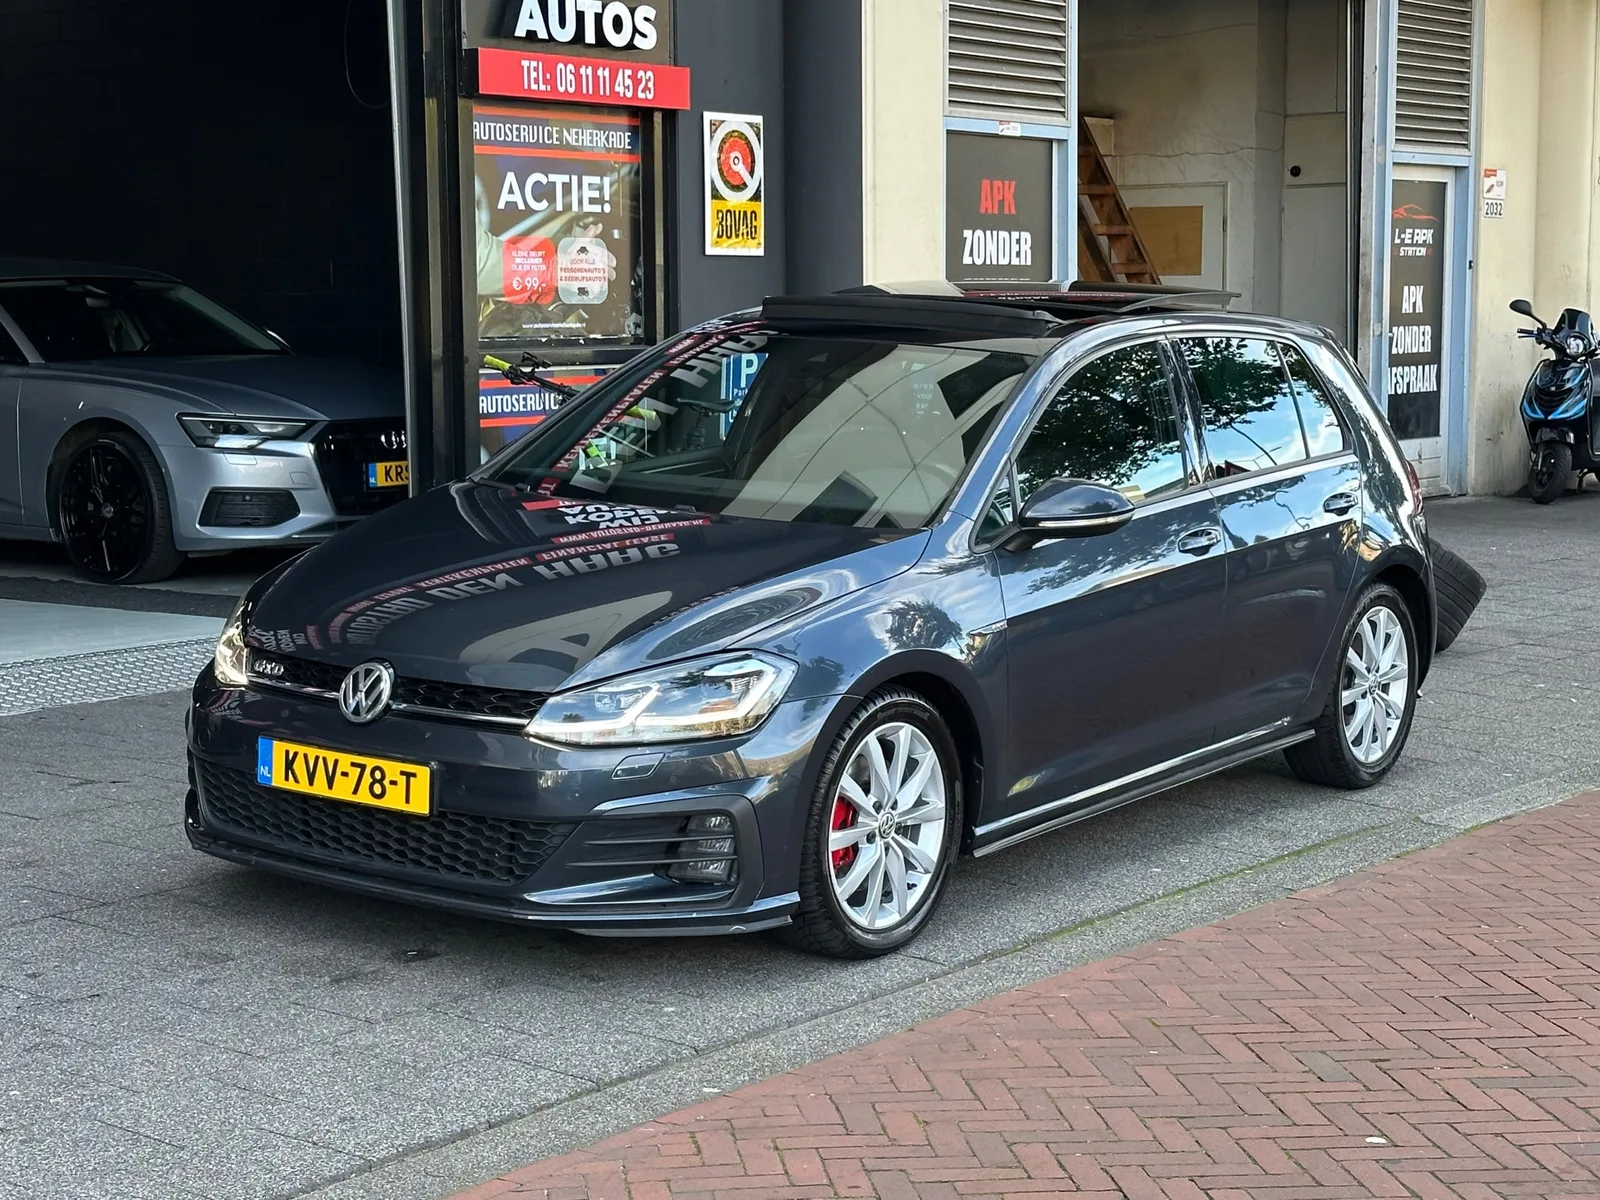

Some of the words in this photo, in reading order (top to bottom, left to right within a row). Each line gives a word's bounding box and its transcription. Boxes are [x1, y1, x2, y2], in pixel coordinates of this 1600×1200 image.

[514, 0, 658, 50] AUTOS
[521, 60, 551, 91] TEL:
[556, 62, 576, 93] 06
[579, 64, 593, 95] 11
[597, 66, 611, 97] 11
[614, 68, 633, 98] 45
[637, 69, 655, 100] 23
[473, 121, 560, 145] AUTOSERVICE
[563, 127, 632, 149] NEHERKADE
[497, 171, 611, 214] ACTIE!
[979, 178, 1017, 215] APK
[716, 208, 758, 240] BOVAG
[1485, 201, 1504, 217] 2032
[962, 229, 1032, 266] ZONDER
[1399, 246, 1427, 257] STATION
[1413, 228, 1434, 245] APK
[1401, 285, 1424, 314] APK
[1391, 325, 1432, 355] ZONDER
[740, 353, 759, 388] P
[479, 392, 560, 414] AUTOSERVIC
[260, 766, 271, 778] NL
[284, 749, 417, 805] KVV-78-T
